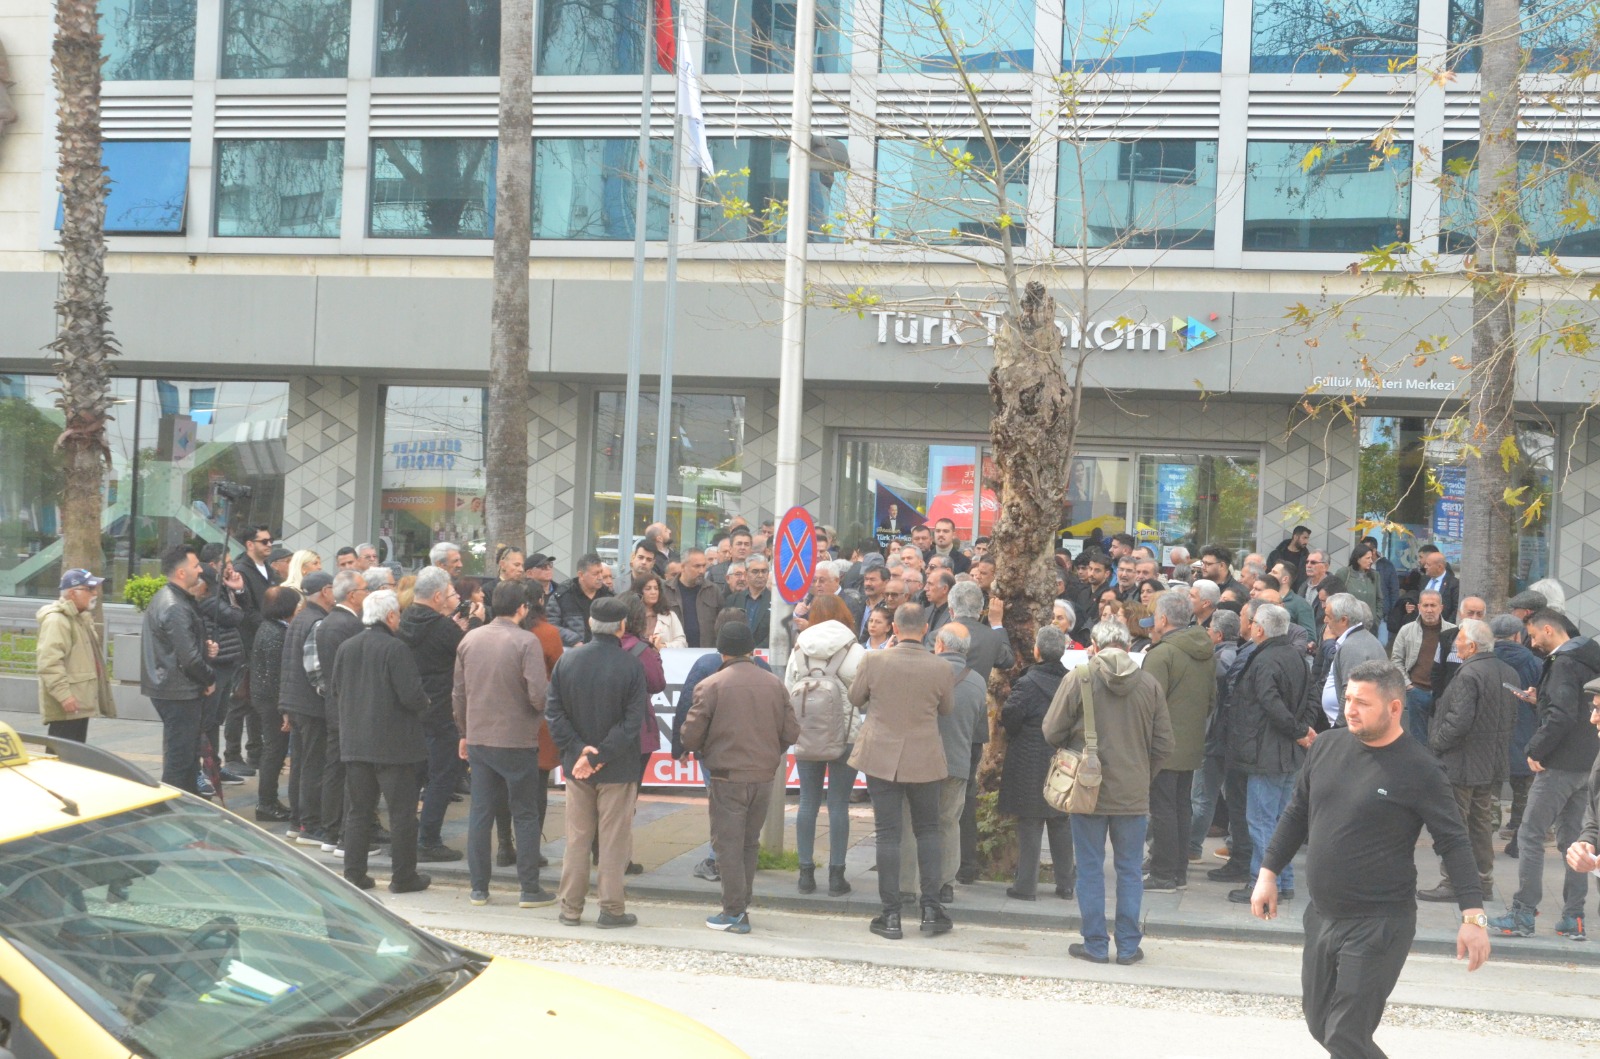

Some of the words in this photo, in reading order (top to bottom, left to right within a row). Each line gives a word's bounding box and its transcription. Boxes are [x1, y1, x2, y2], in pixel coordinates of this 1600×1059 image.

[871, 310, 965, 346] Türk
[980, 311, 1167, 351] Tkom
[1313, 376, 1351, 387] Güllük
[1355, 377, 1402, 389] Müteri
[1405, 378, 1455, 391] Merkezi
